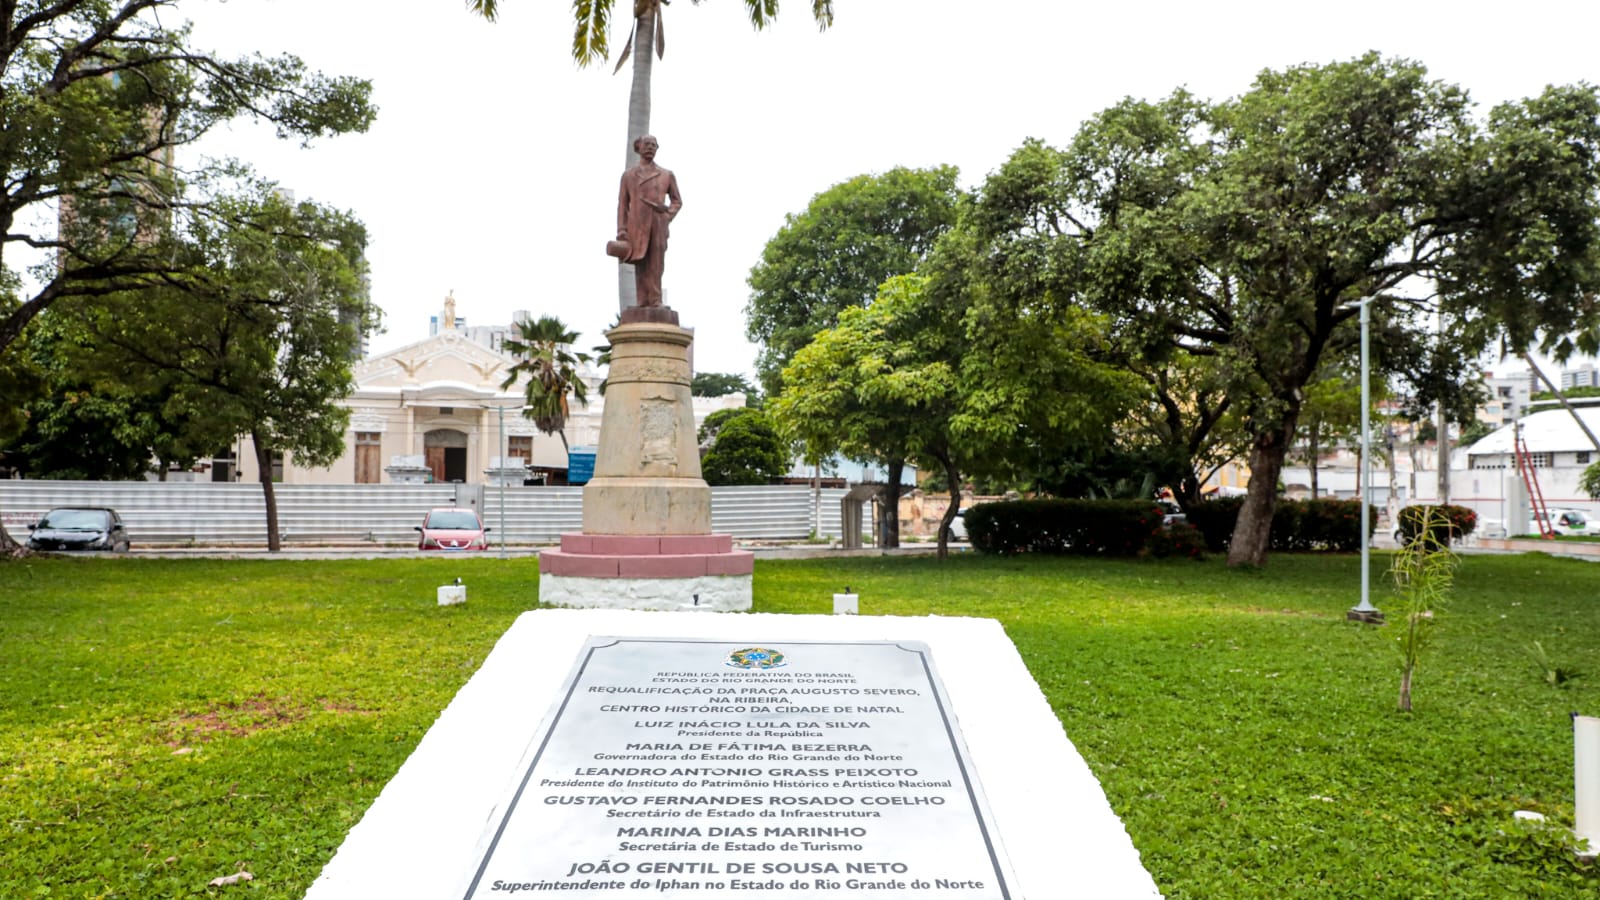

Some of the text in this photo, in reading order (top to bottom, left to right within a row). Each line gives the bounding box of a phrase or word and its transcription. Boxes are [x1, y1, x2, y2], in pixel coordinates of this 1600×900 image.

[588, 686, 713, 695] REQUALIFICAÇÃO
[665, 705, 746, 713] HISTÓRICO
[679, 720, 741, 728] INÁCIO
[718, 742, 786, 751] FÁTIMA
[575, 768, 667, 776] LEANDRO
[768, 769, 829, 777] GRASS
[835, 768, 918, 776] PEIXOTO
[540, 779, 605, 787] Presidente
[627, 779, 678, 787] Instituto
[701, 779, 769, 787] Patrimônio
[773, 780, 829, 788] Histórico
[898, 780, 952, 788] Nacional
[544, 796, 945, 805] GUSTAVO FERNANDES ROSADO COELHO
[606, 809, 881, 818] Secretário de Estado da Infraestrutura
[617, 827, 867, 837] MARINA DIAS MARINHO
[618, 841, 863, 851] Secretária de Estado de Turismo
[566, 859, 908, 876] JOÃO GENTIL DE SOUSA NETO
[491, 879, 626, 893] Superintendente
[630, 879, 652, 889] do
[655, 879, 700, 892] Iphan
[730, 879, 784, 890] Estado
[789, 879, 810, 890] do
[815, 879, 841, 890] Rio
[845, 879, 906, 890] Grande
[910, 879, 931, 889] do
[934, 879, 984, 889] Norte
